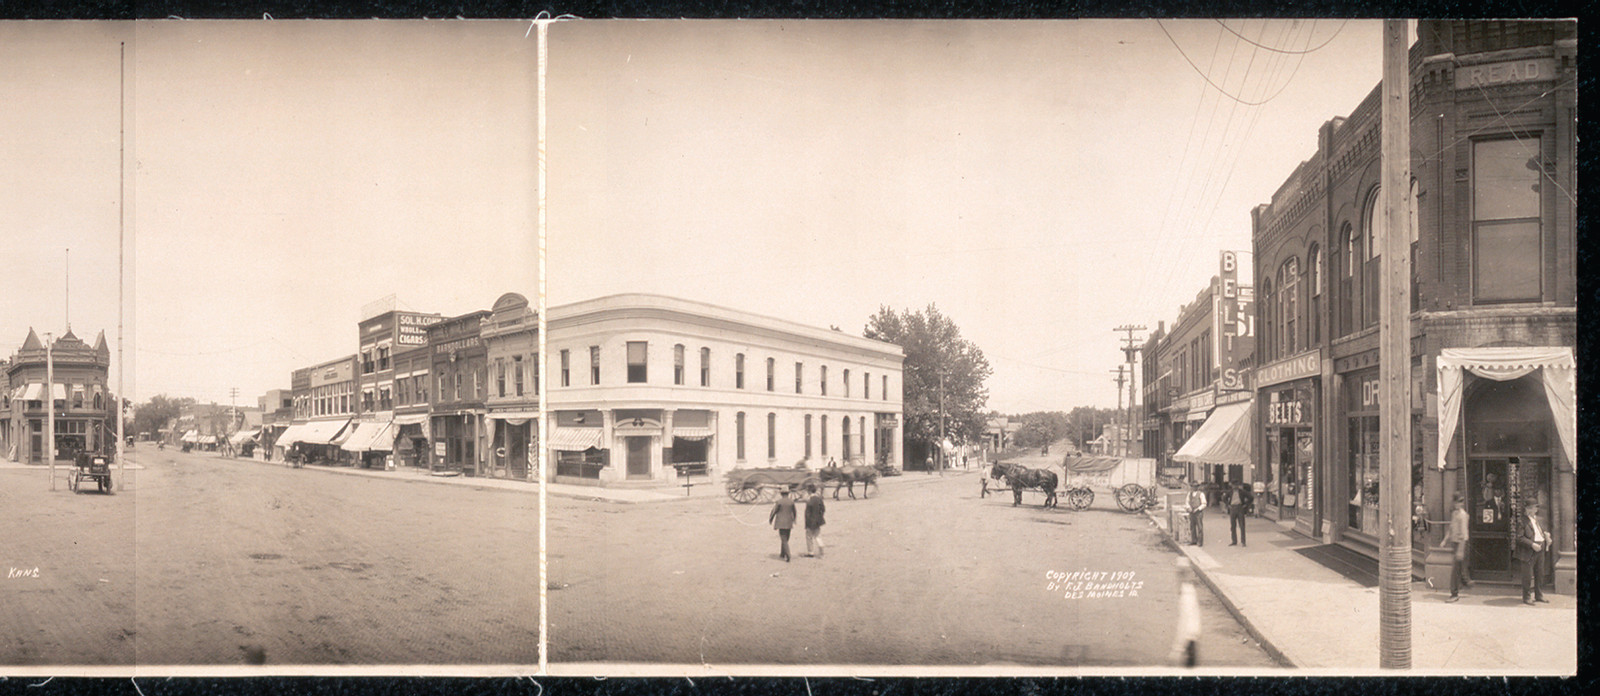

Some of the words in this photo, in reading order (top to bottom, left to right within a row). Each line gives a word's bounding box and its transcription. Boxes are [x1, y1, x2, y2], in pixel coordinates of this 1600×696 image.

[1470, 62, 1539, 85] READ
[1258, 356, 1316, 382] CLOTHING
[1269, 401, 1301, 424] BELT'S
